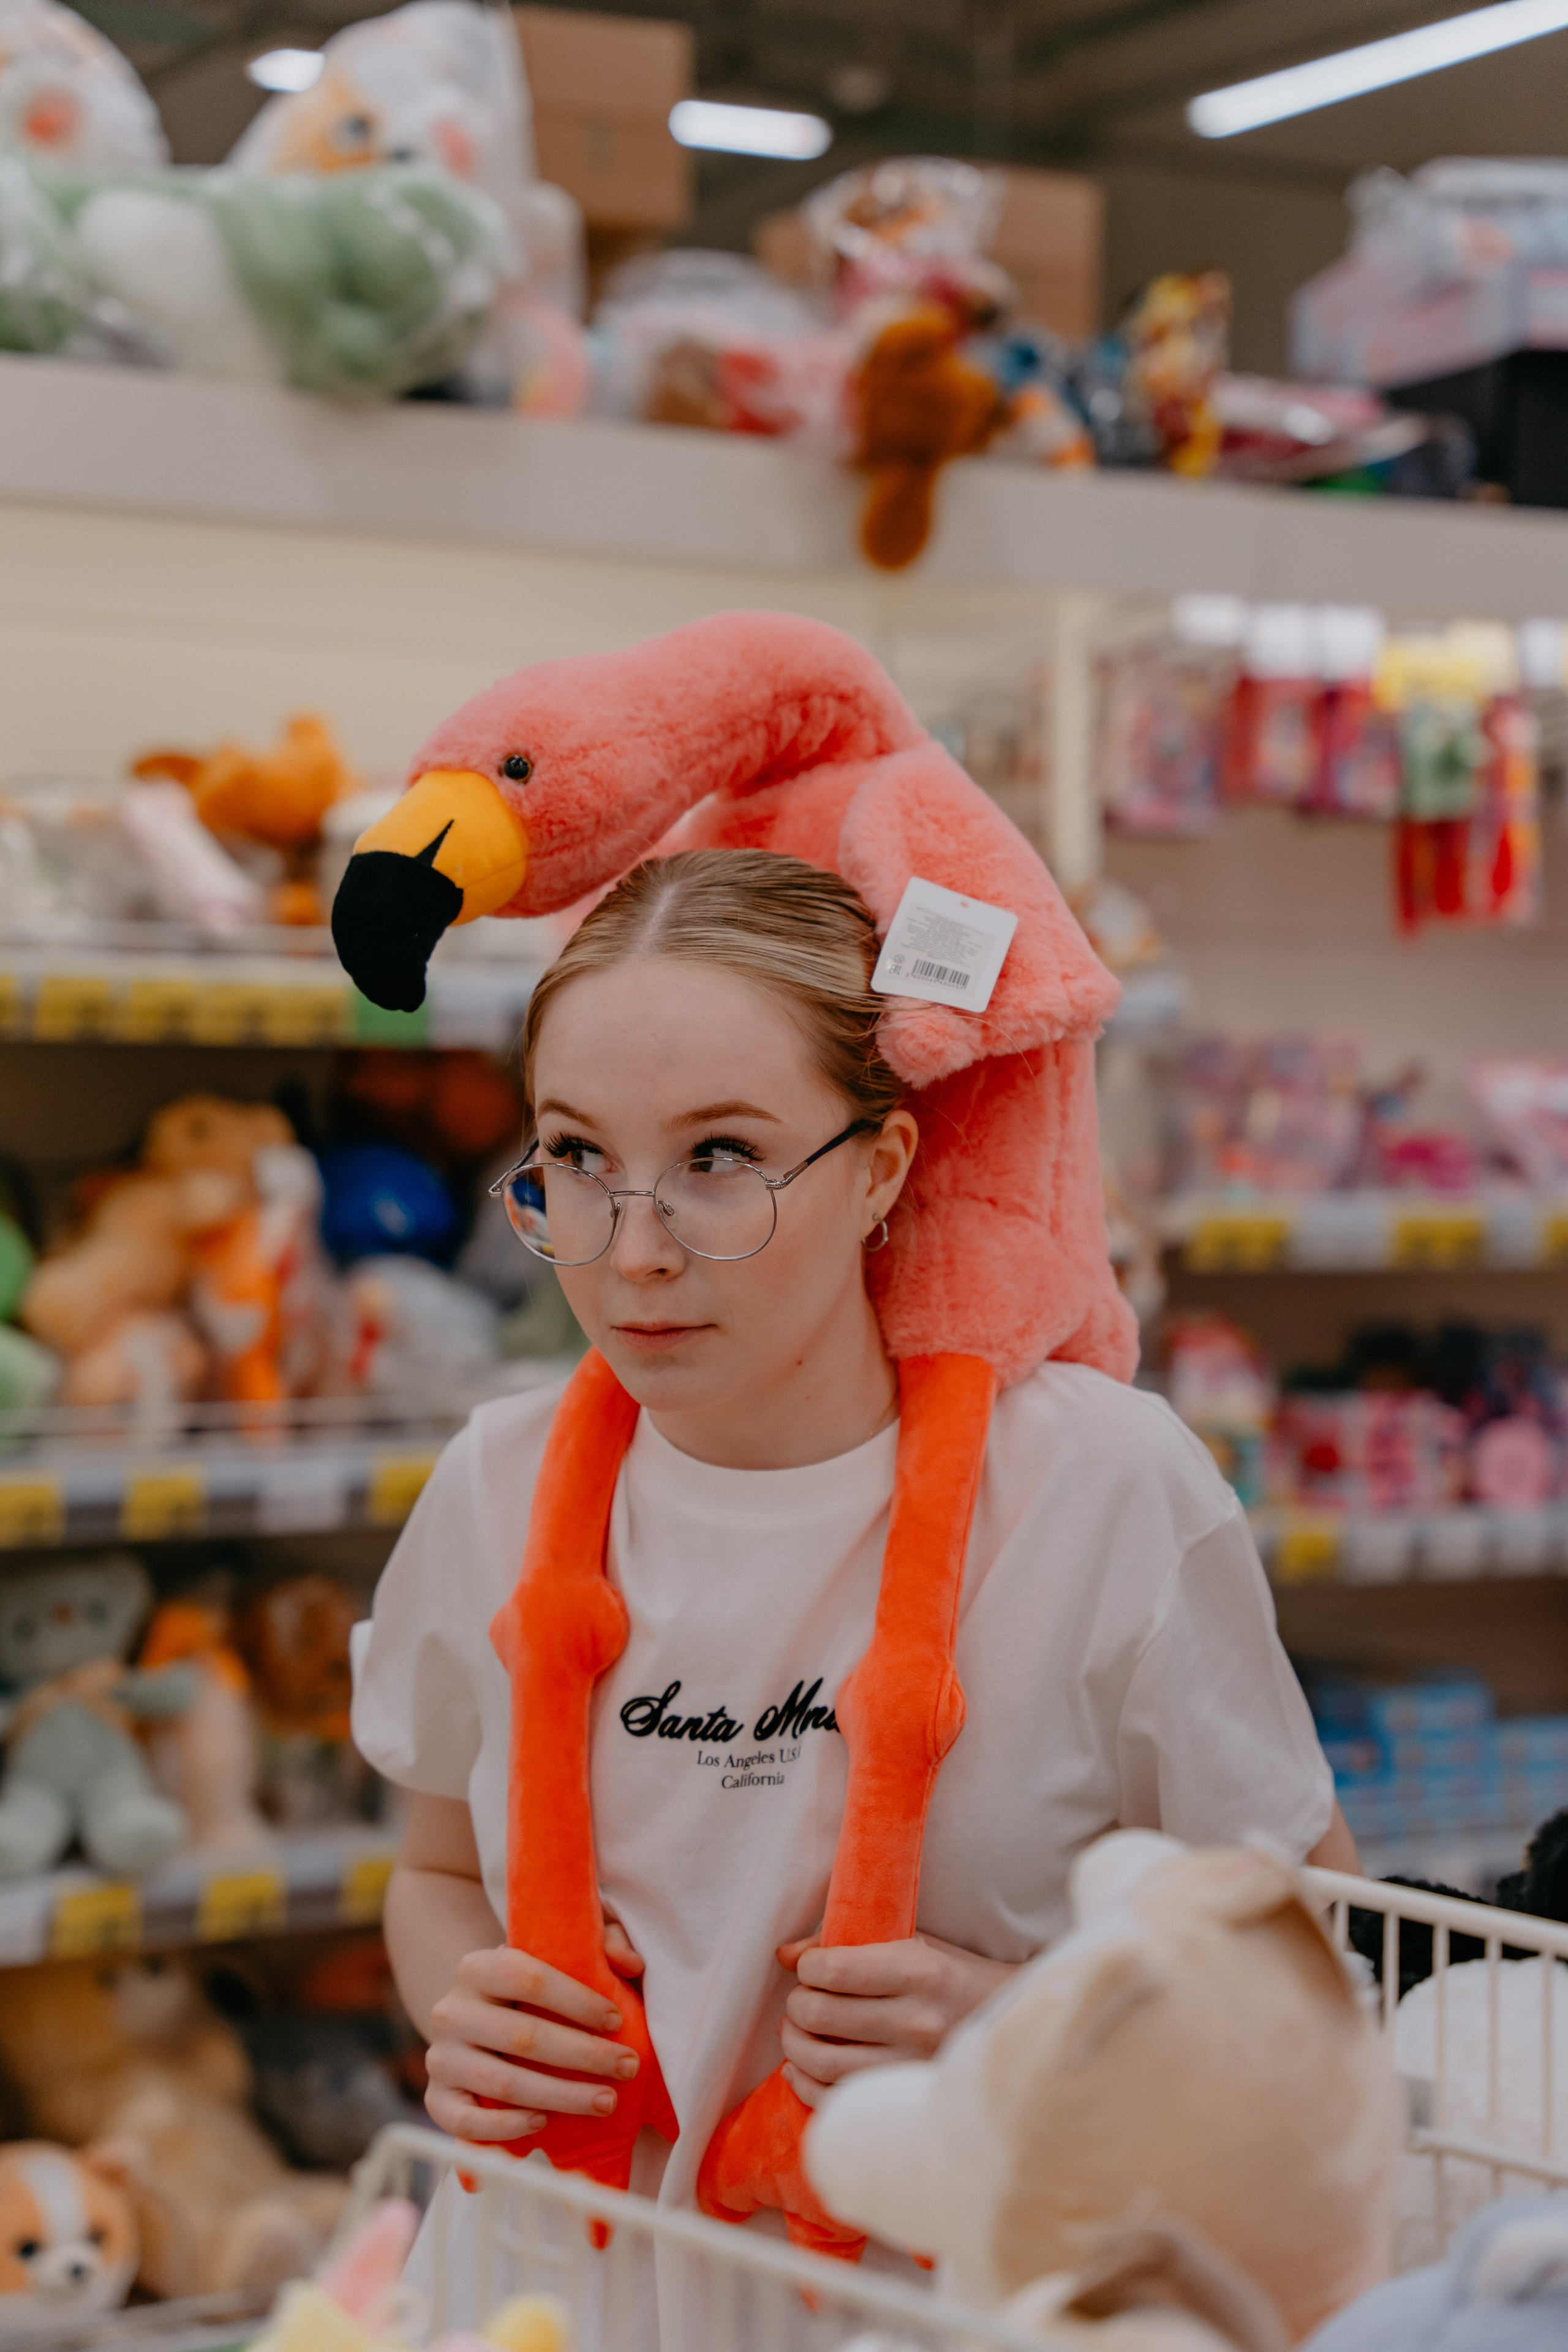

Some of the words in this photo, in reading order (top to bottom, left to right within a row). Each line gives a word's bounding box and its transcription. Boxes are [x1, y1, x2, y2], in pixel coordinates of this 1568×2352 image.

[620, 1680, 744, 1743] Santa
[696, 1750, 720, 1767] Los
[723, 1750, 775, 1771] Angeles
[721, 1772, 785, 1790] California
